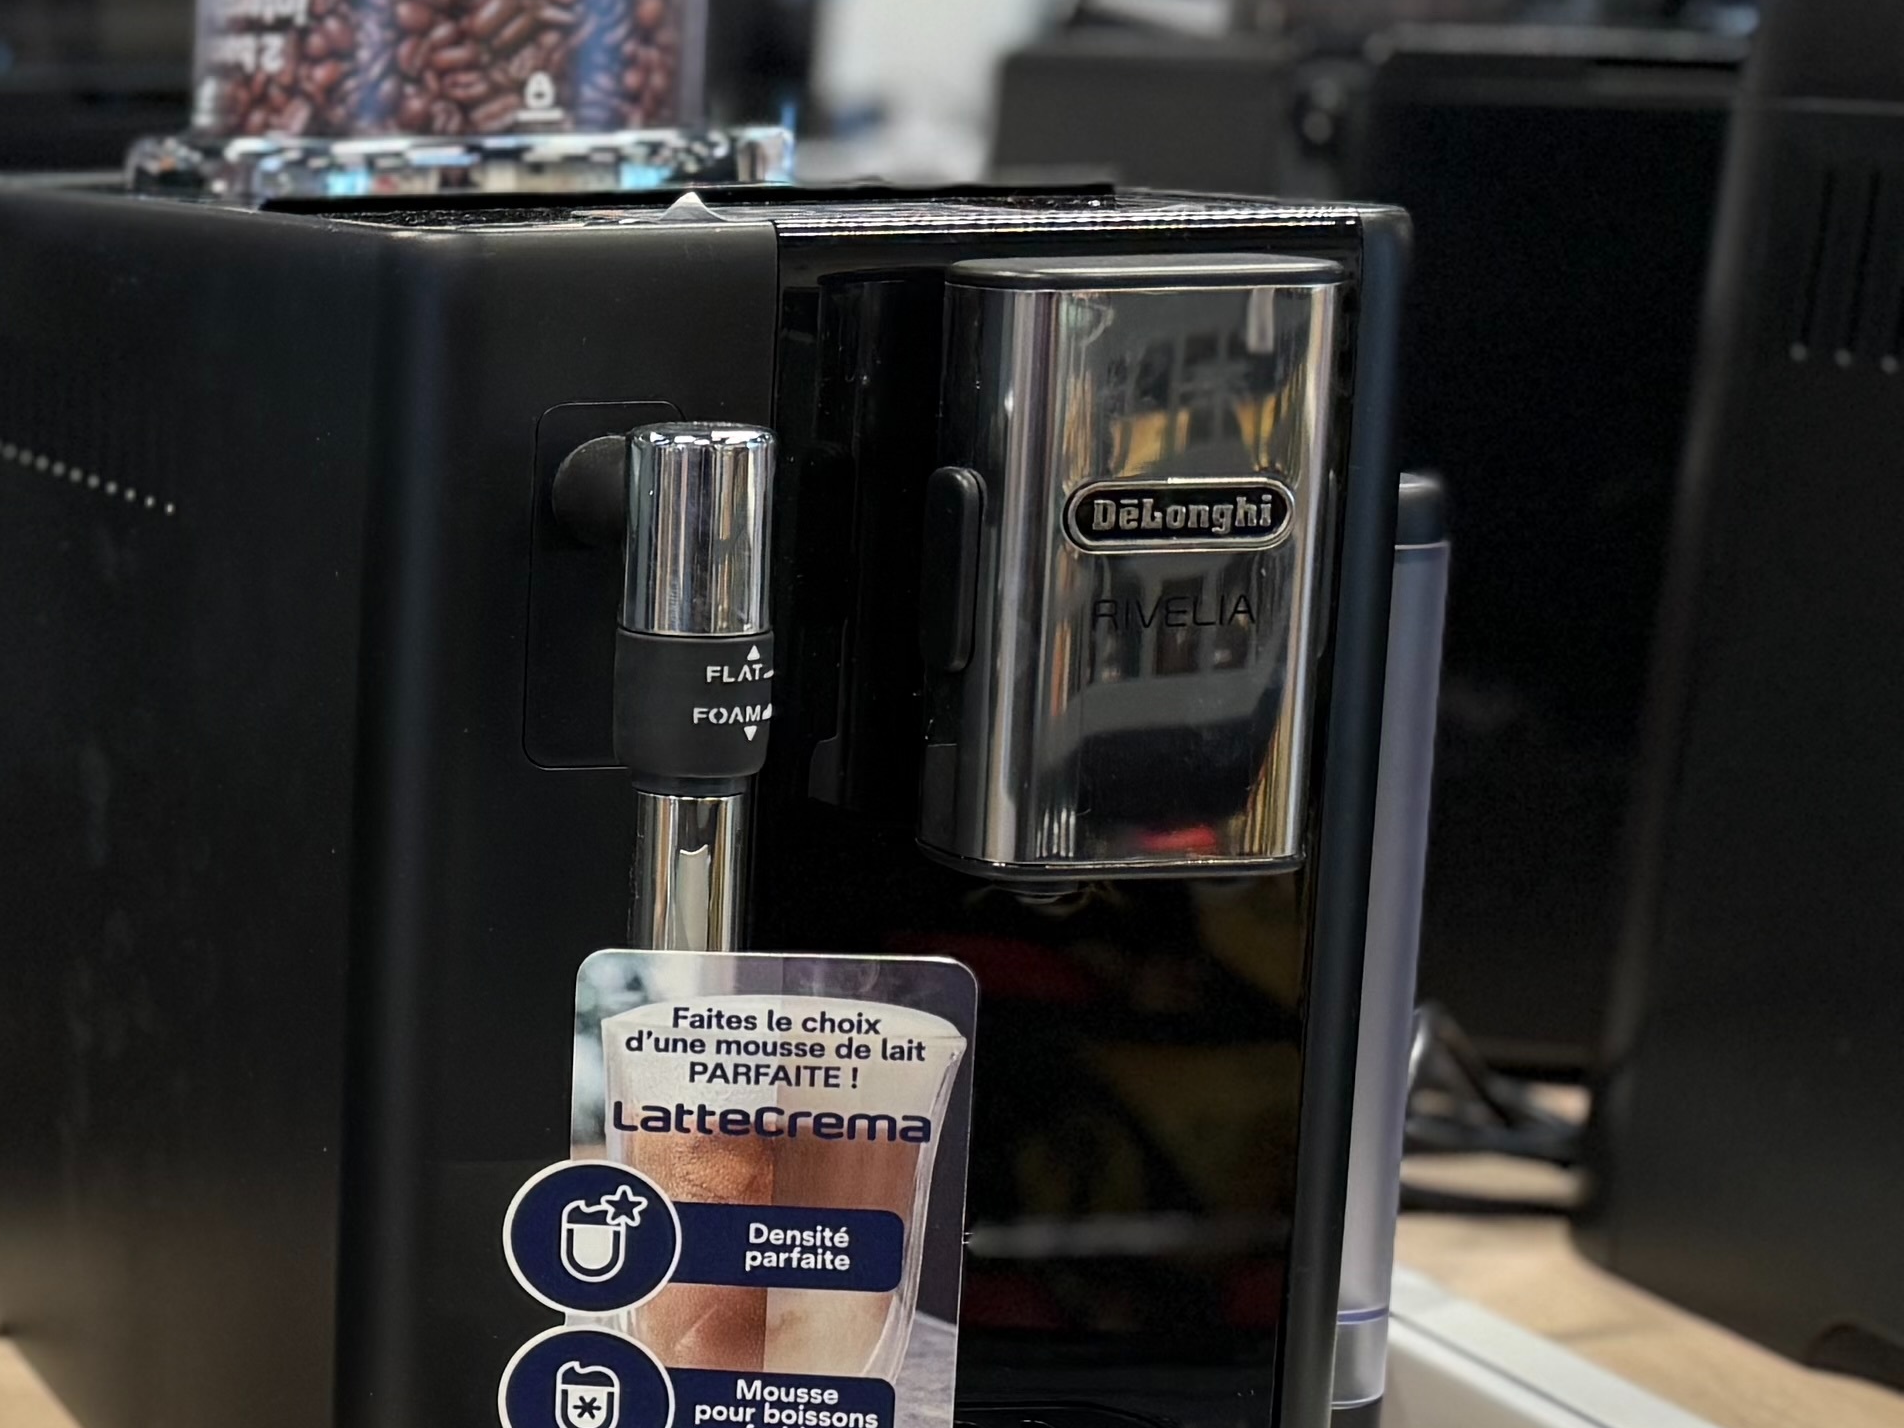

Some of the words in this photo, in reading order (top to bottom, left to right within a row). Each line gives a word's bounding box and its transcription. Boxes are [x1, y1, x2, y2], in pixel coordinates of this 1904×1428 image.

[1093, 594, 1256, 631] RIVELIA
[707, 664, 763, 682] FLAT
[693, 705, 761, 724] FOAM
[672, 1008, 757, 1031] Faites
[767, 1009, 791, 1032] le
[802, 1012, 881, 1035] choix
[715, 1036, 825, 1059] mousse
[835, 1038, 871, 1059] de
[881, 1039, 925, 1062] lait
[689, 1063, 841, 1088] PARFAITE
[852, 1067, 858, 1088] !
[613, 1101, 932, 1143] LatteCrema
[749, 1222, 849, 1248] Densité
[745, 1246, 850, 1272] parfaite
[736, 1379, 838, 1405] Mousse
[695, 1402, 755, 1426] pour
[763, 1406, 878, 1428] boissons
